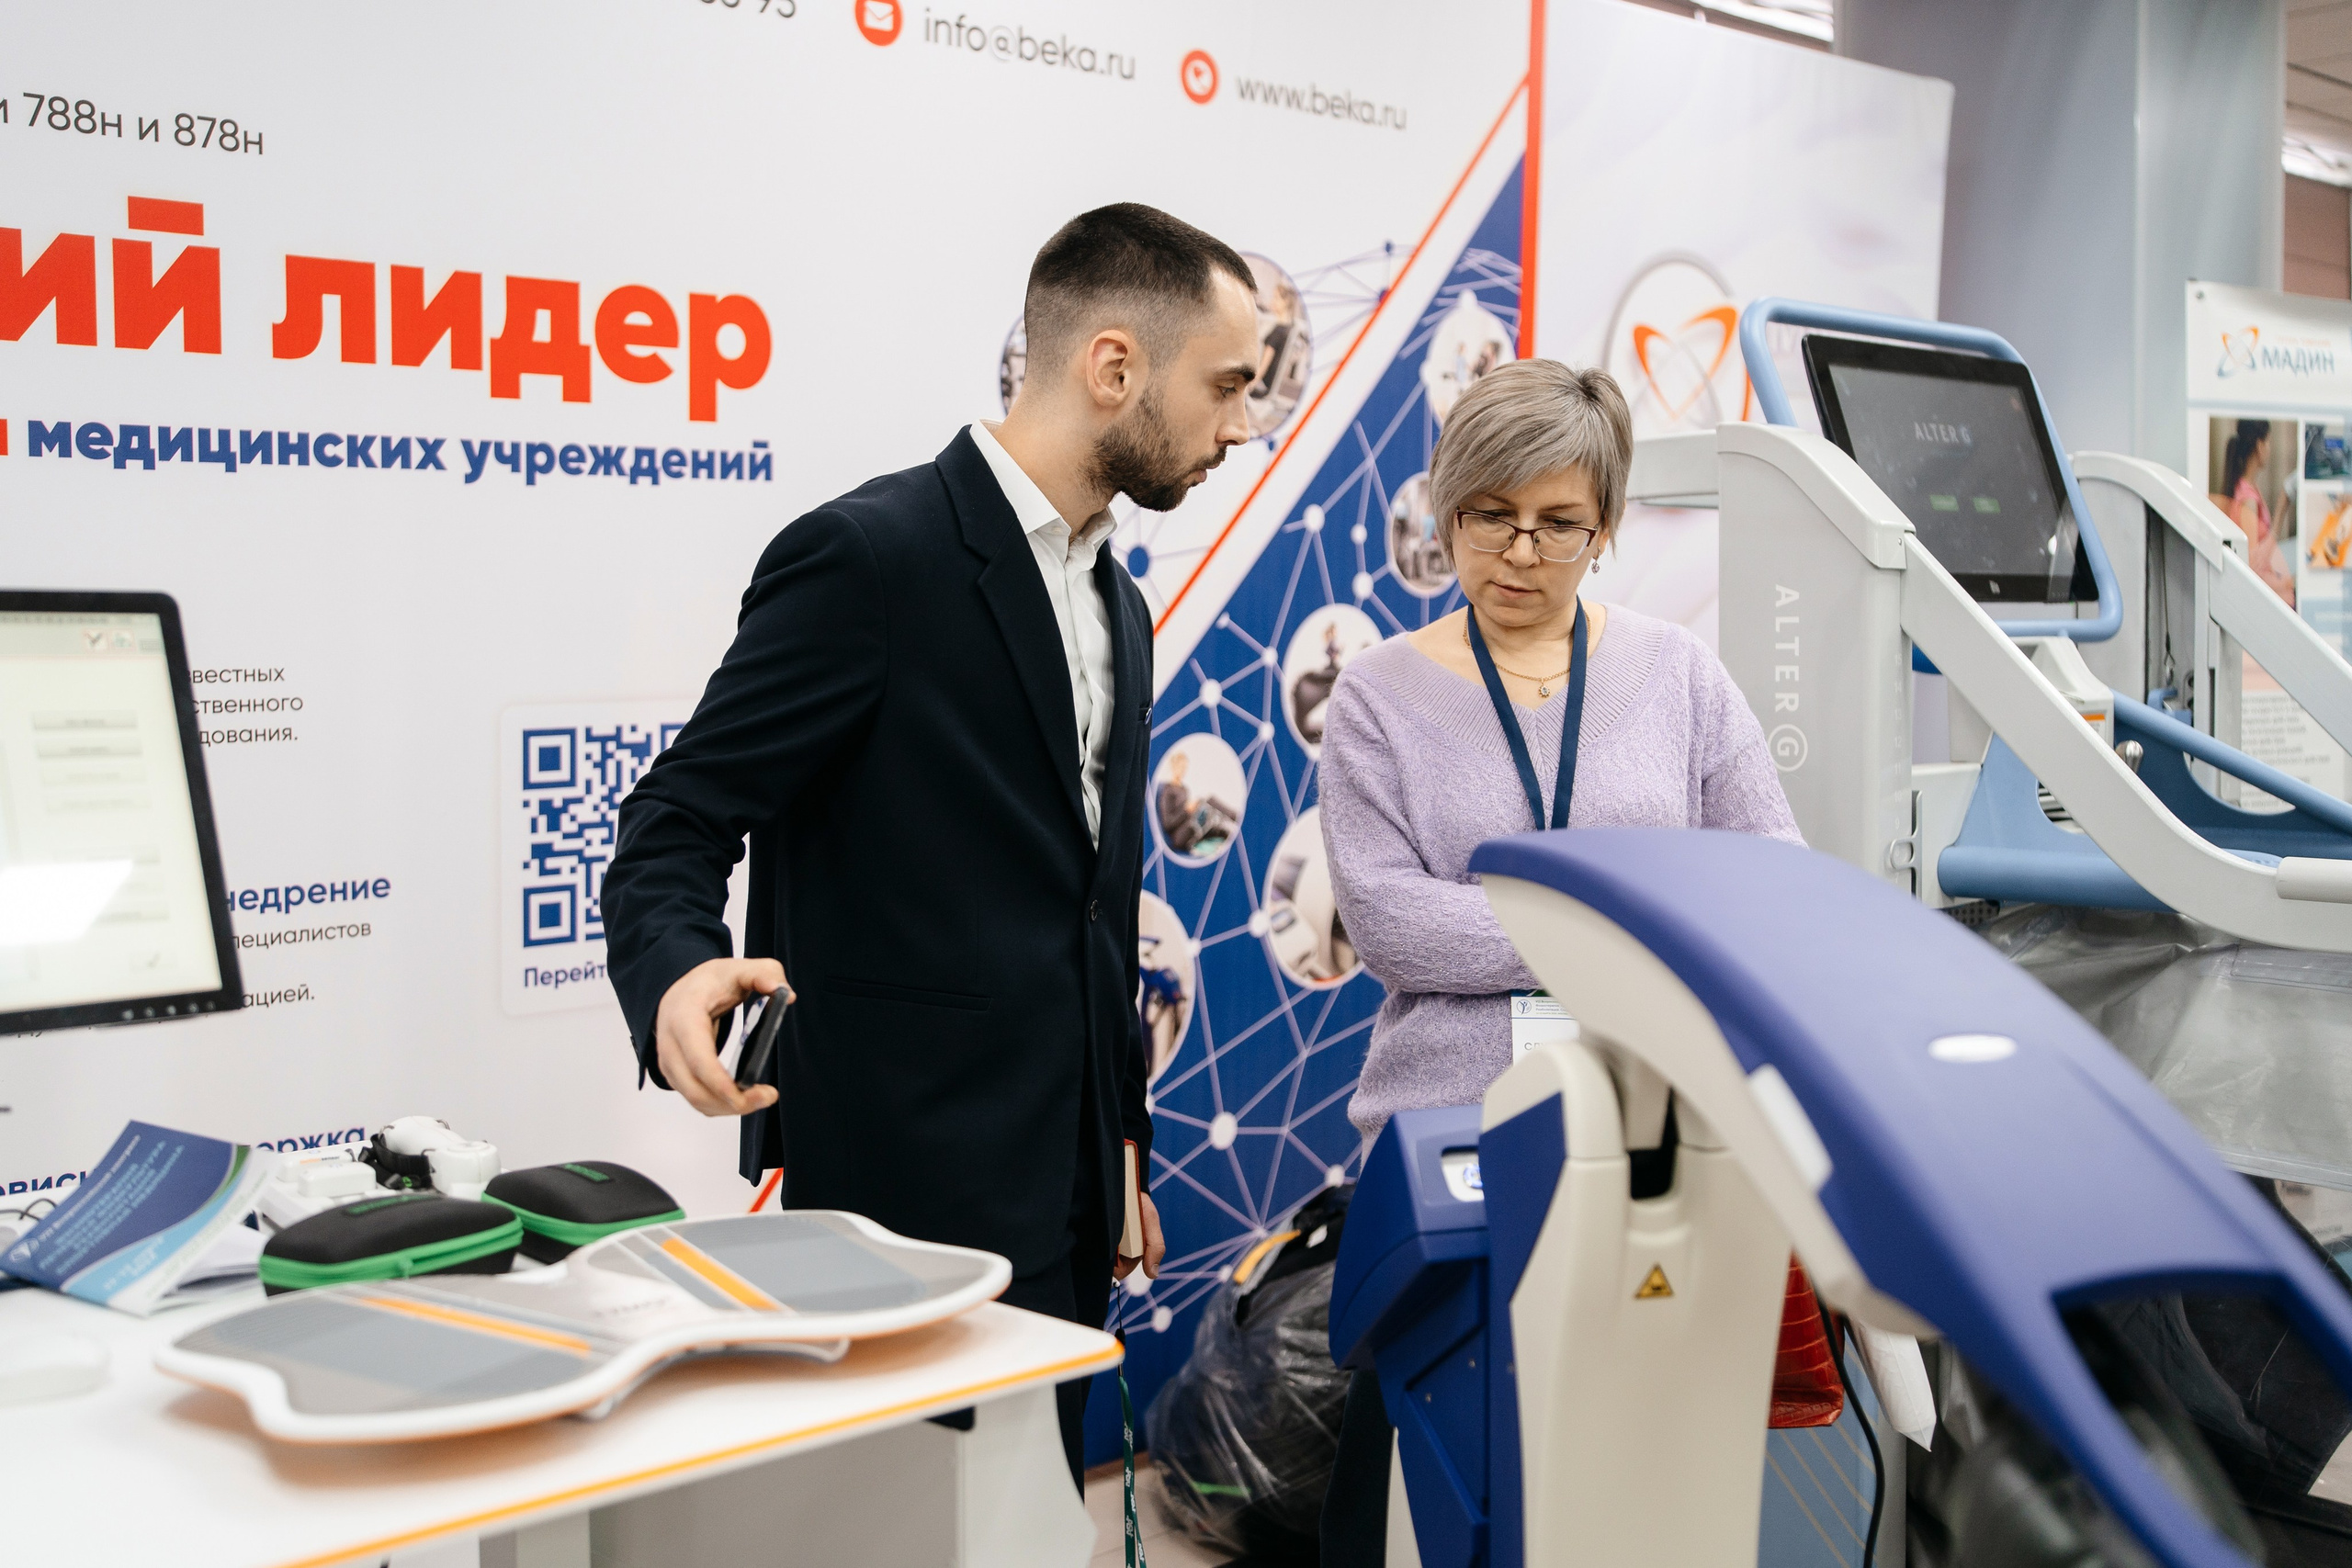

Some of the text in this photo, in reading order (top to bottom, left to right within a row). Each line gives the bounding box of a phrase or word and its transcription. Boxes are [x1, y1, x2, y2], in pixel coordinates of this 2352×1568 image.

[924, 6, 1136, 80] info@beka.ru
[23, 92, 122, 138] 788н
[138, 117, 160, 142] и
[174, 113, 263, 155] 878н
[1235, 76, 1408, 130] www.beka.ru
[0, 195, 774, 423] ий лидер
[2261, 344, 2335, 377] МАДИН
[28, 419, 447, 474] медицинских
[463, 435, 774, 487] учреждений
[189, 667, 285, 683] вестных
[199, 727, 299, 748] дования.
[524, 961, 606, 988] Перейт
